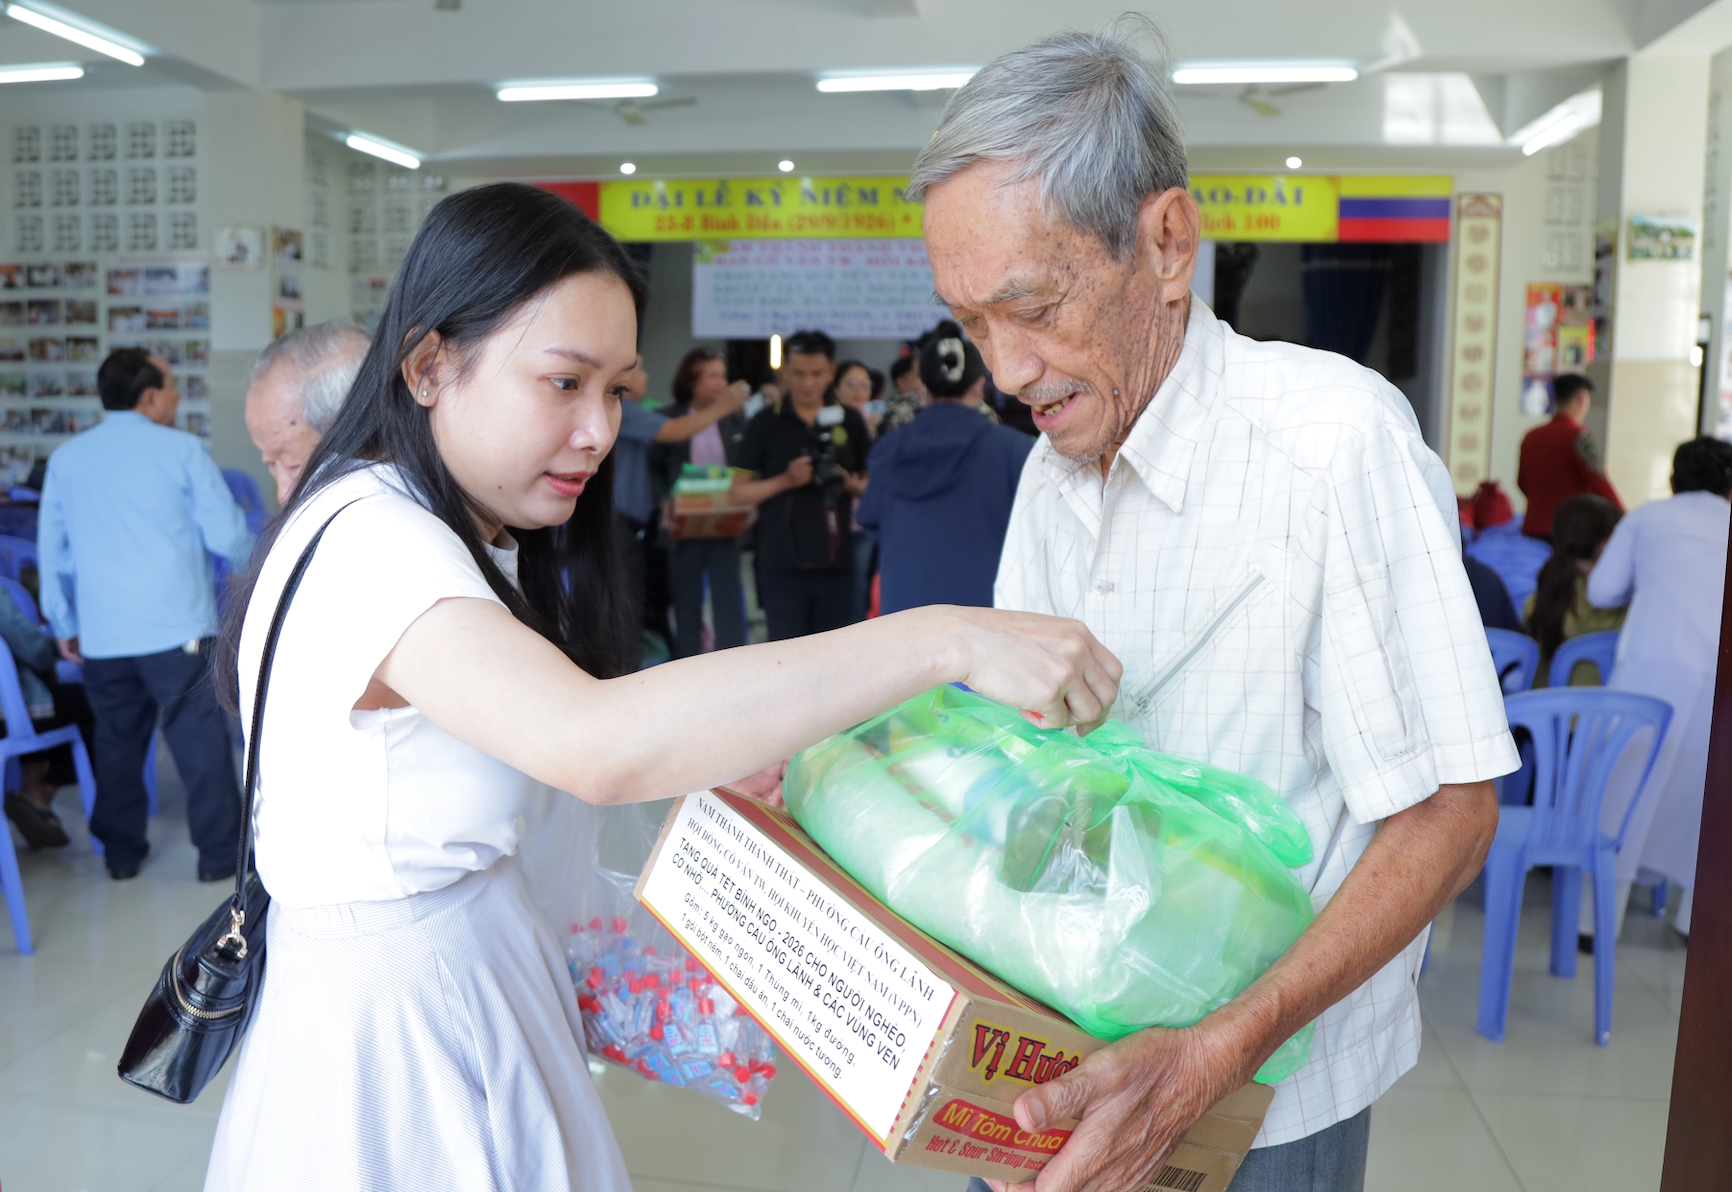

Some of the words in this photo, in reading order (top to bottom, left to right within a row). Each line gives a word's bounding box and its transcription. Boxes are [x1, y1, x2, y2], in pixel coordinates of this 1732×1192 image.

[672, 852, 687, 869] CƠ
[765, 937, 787, 965] ÔNG
[785, 958, 815, 990] LÃNH
[812, 983, 822, 999] &
[822, 992, 846, 1019] CÁC
[876, 1040, 901, 1071] VEN
[687, 817, 703, 836] HỘI
[767, 887, 786, 908] HỘI
[819, 932, 840, 954] HỌC
[867, 970, 889, 998] NAM
[887, 993, 922, 1028] (VPPN)
[697, 797, 717, 819] NAM
[743, 836, 775, 869] THÁNH
[873, 942, 900, 973] ÔNG
[899, 966, 935, 1002] LÃNH
[718, 872, 737, 894] TẾT
[734, 887, 757, 914] BÍNH
[755, 907, 778, 934] NGỌ
[781, 931, 806, 958] 2026
[805, 951, 828, 978] CHO
[827, 971, 866, 1012] NGƯỜI
[681, 912, 687, 922] 1
[684, 919, 698, 933] gói
[724, 955, 730, 965] 1
[729, 962, 746, 981] chai
[771, 1001, 777, 1012] 1
[776, 1009, 795, 1029] chai
[792, 1025, 815, 1051] nước
[815, 1045, 842, 1080] tương.
[703, 910, 710, 921] 5
[708, 916, 719, 933] kg
[717, 928, 734, 945] gạo
[733, 943, 755, 968] ngon,
[758, 963, 764, 973] 1
[807, 1010, 823, 1034] 1kg
[942, 1103, 974, 1128] Mì
[971, 1113, 1012, 1141] Tôm
[972, 1024, 1010, 1080] Vị
[925, 1135, 951, 1153] Hot
[958, 1141, 988, 1159] Sour
[986, 1147, 1027, 1169] Shrimp
